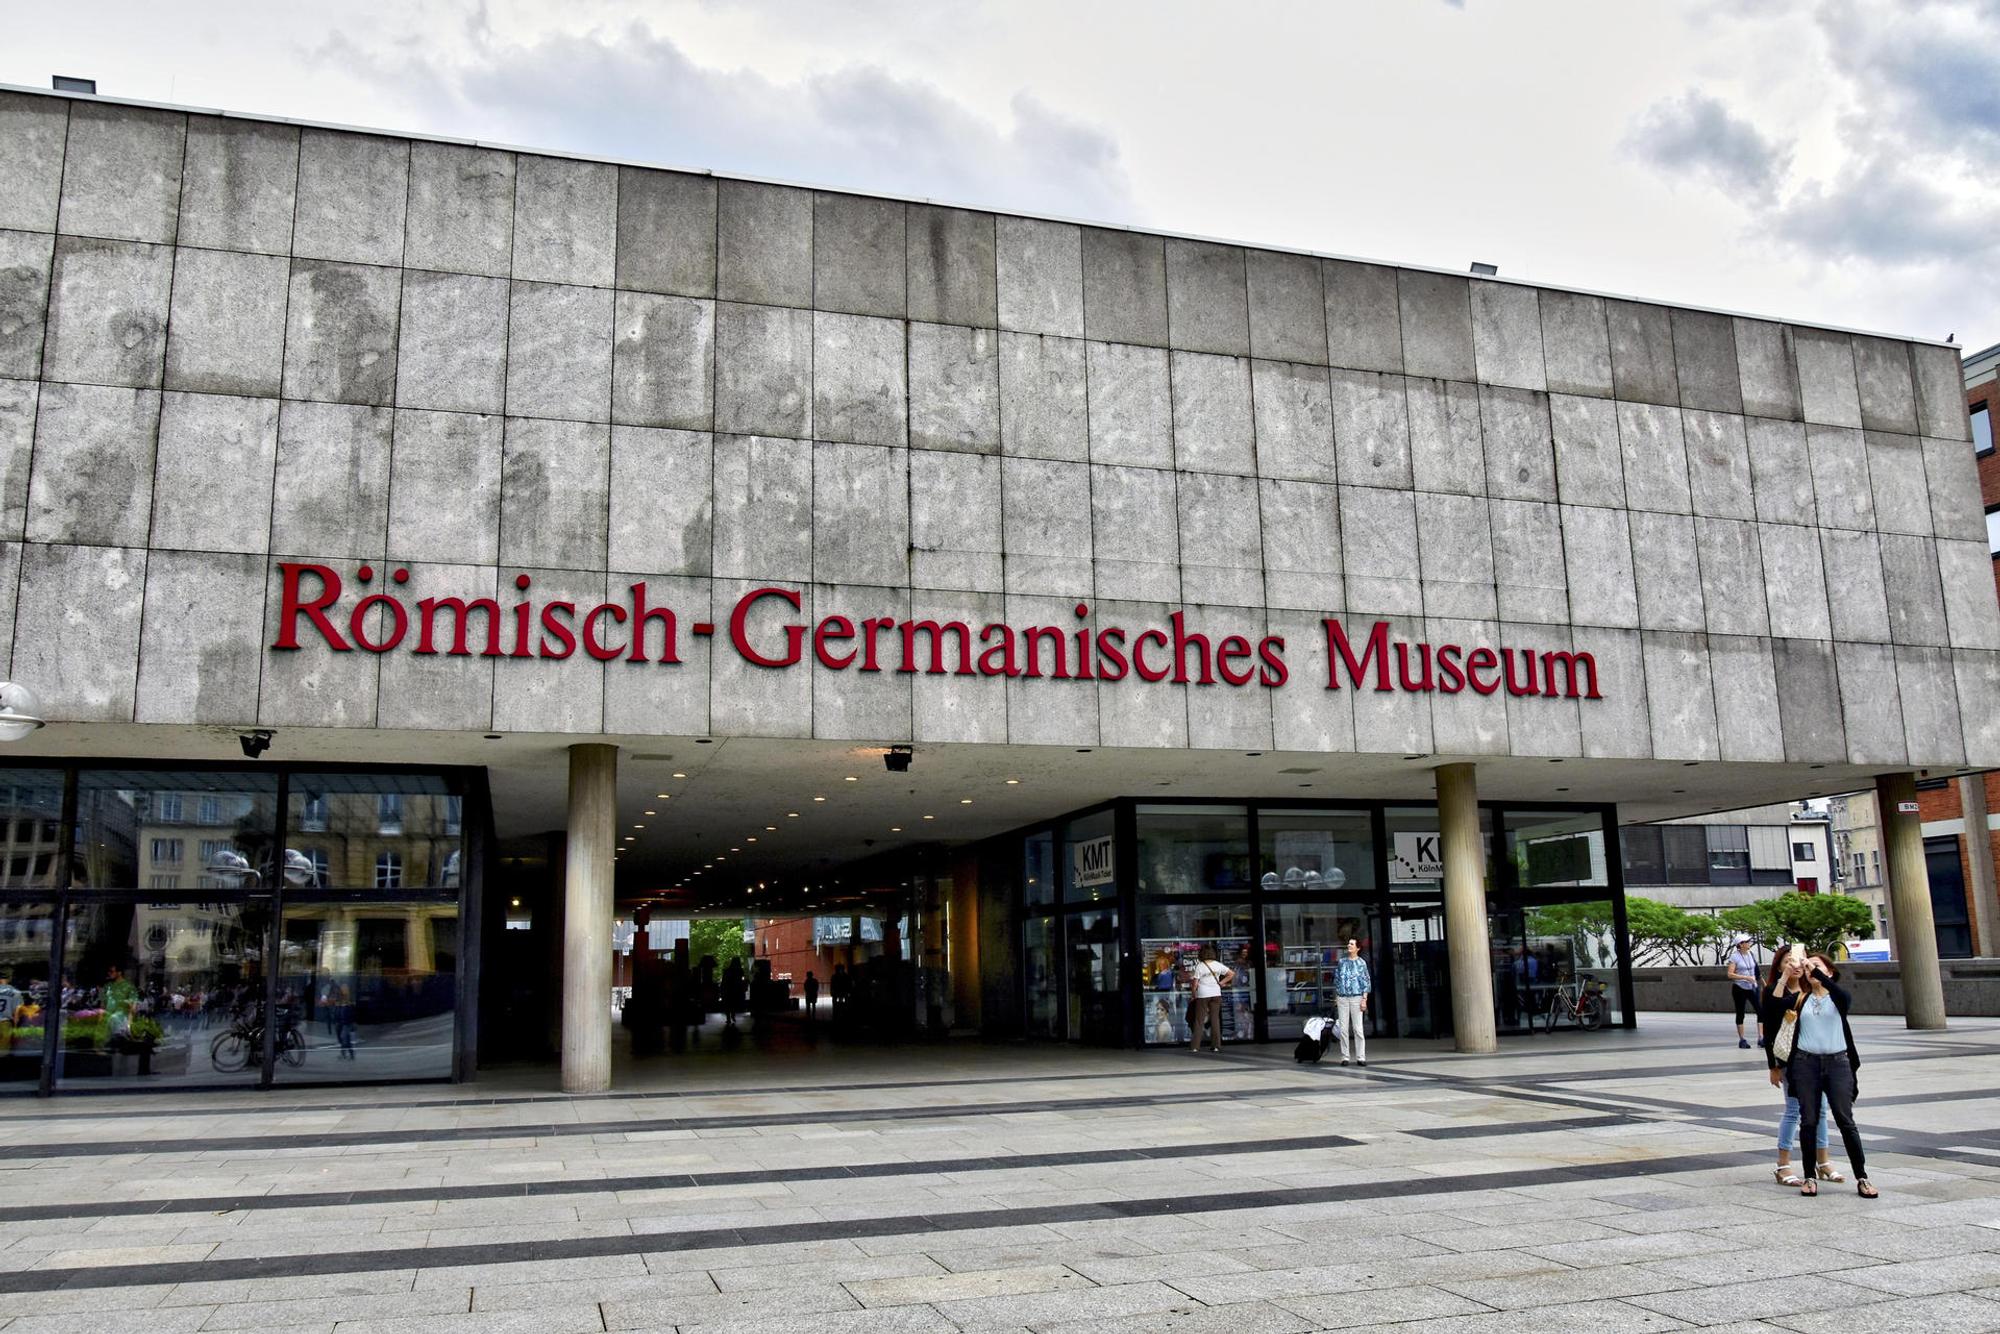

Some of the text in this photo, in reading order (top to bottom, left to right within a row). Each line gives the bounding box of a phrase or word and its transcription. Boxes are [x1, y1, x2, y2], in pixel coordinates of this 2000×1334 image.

[271, 562, 1603, 699] Römisch-Germanisches Museum
[1082, 840, 1110, 871] KMT
